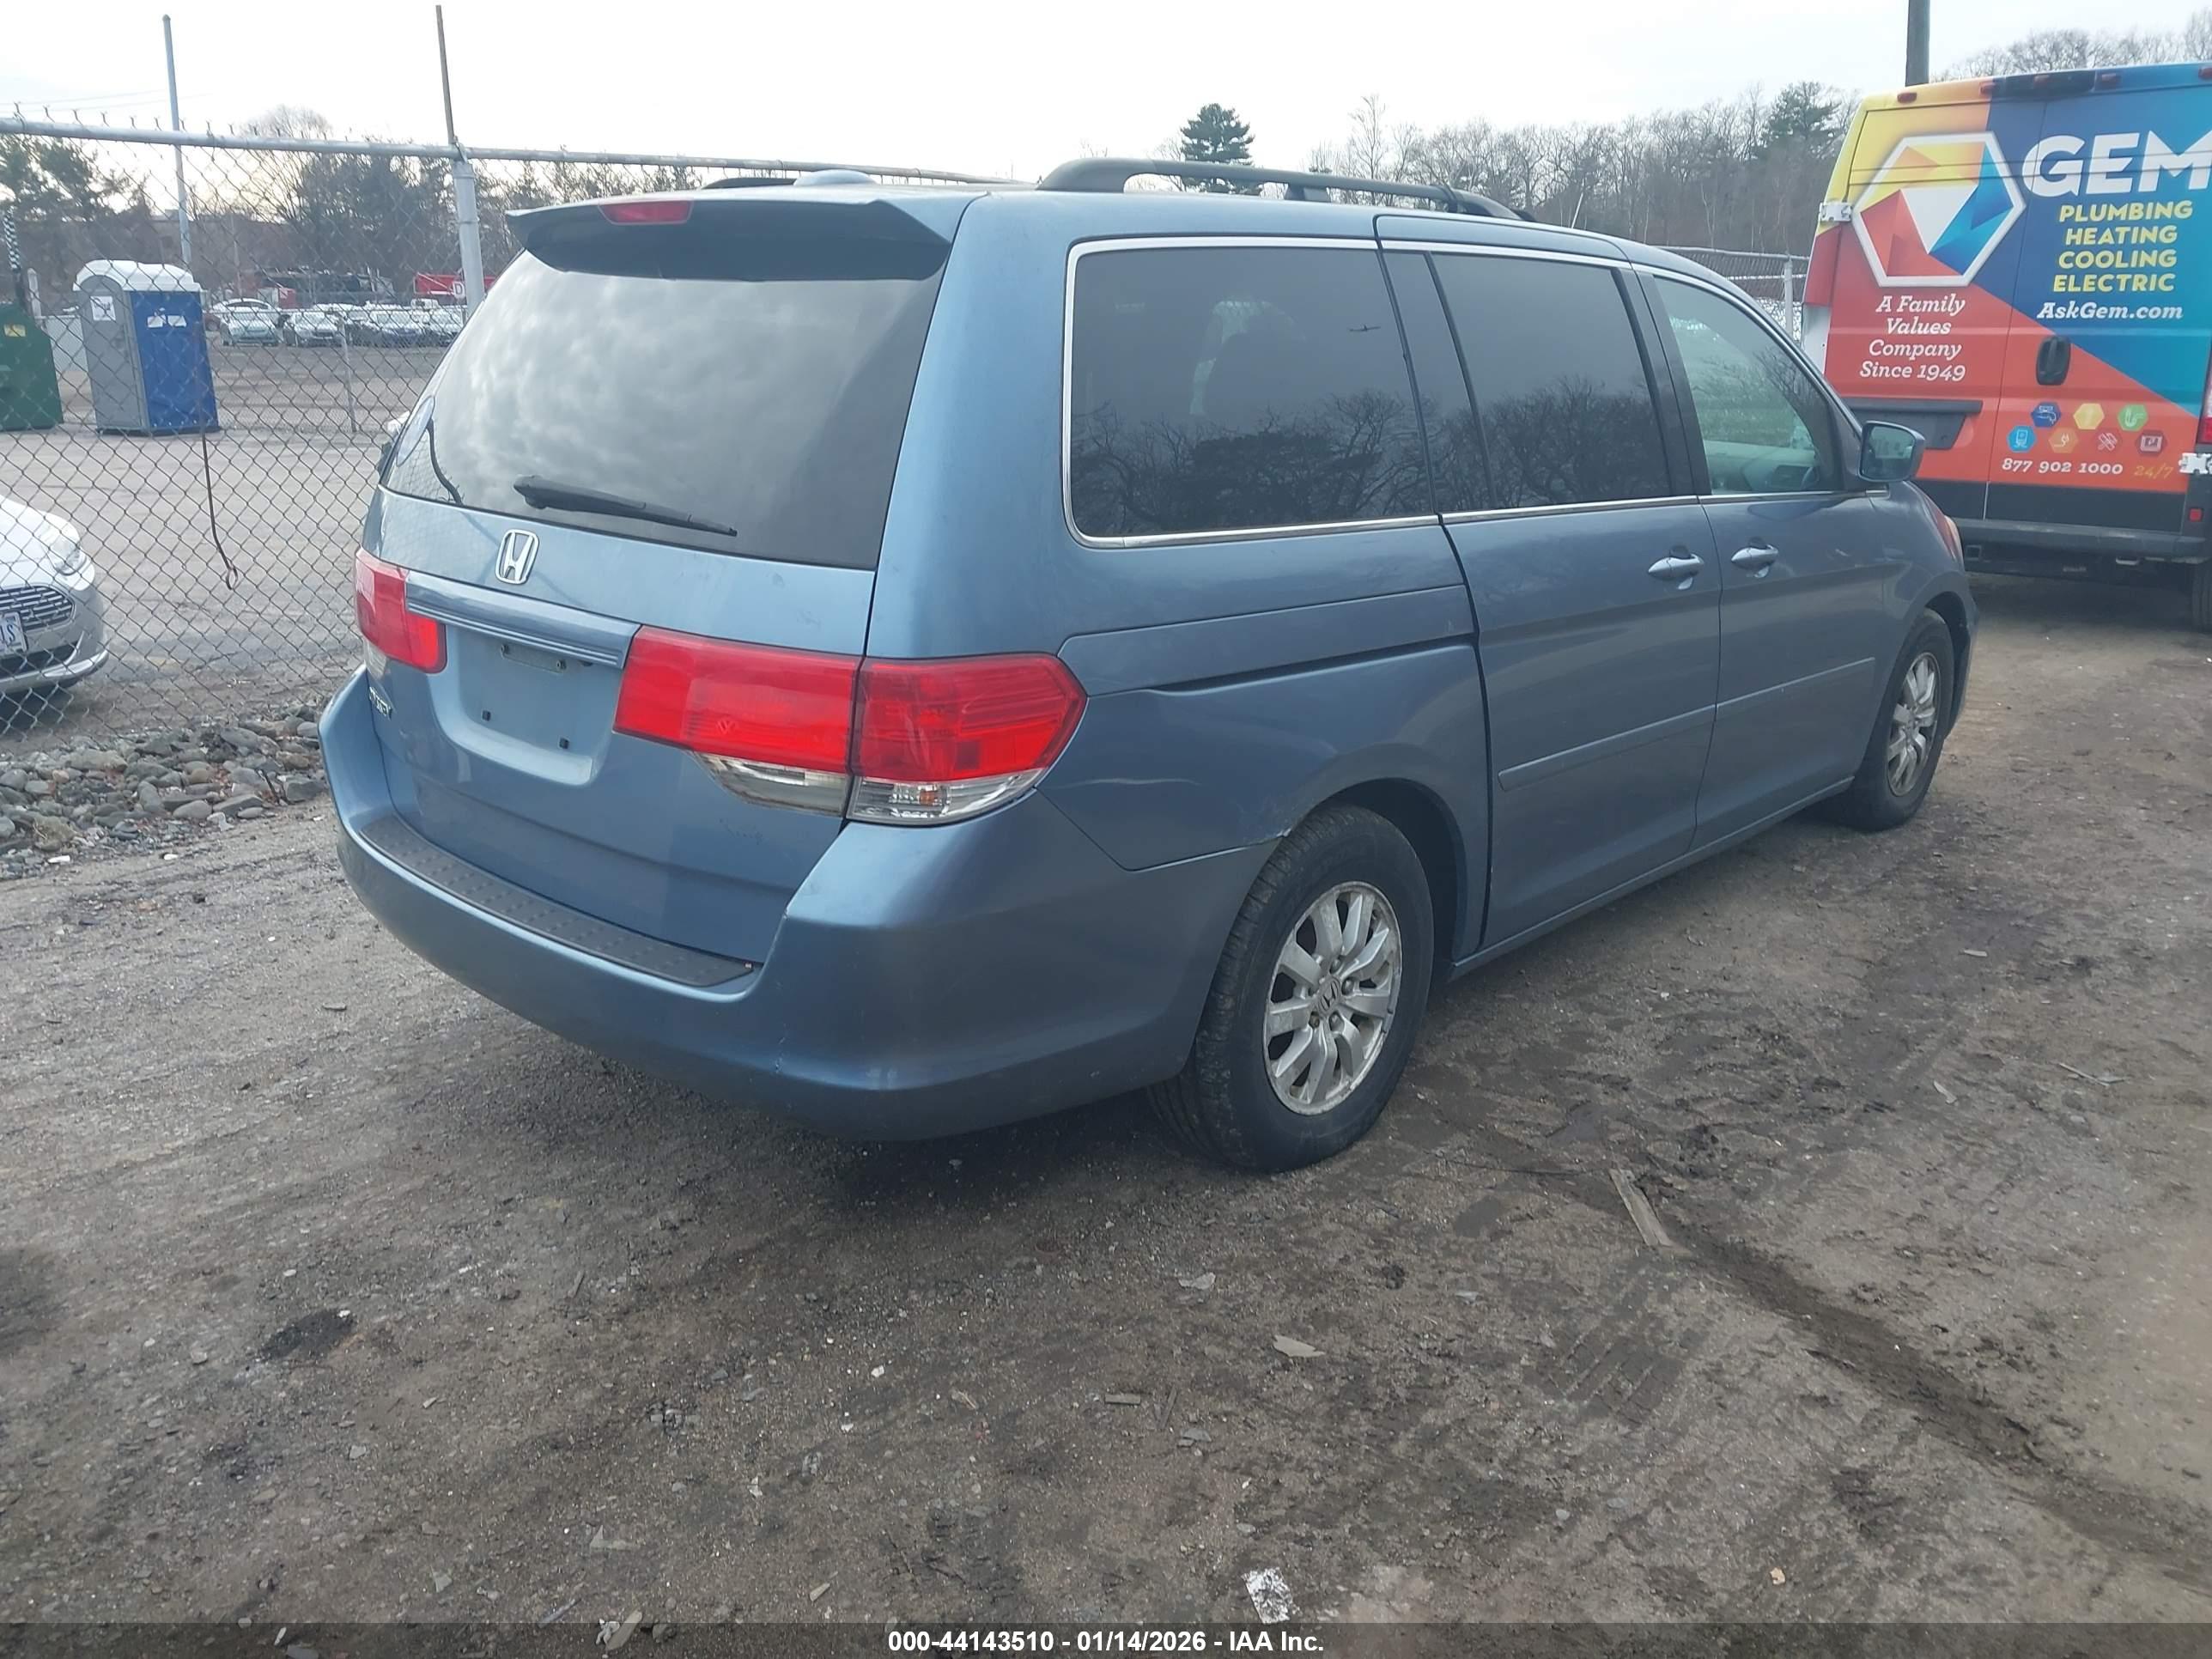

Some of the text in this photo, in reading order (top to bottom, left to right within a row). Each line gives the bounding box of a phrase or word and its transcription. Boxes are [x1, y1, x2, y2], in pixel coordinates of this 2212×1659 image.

[2021, 130, 2212, 198] GEM
[2058, 200, 2193, 222] PLUMBING
[2065, 225, 2178, 246] HEATING
[2058, 249, 2178, 269] COOLING
[2053, 273, 2176, 292] ELECTRIC
[1875, 293, 1966, 316] A Family
[2037, 301, 2184, 319] AskGem.com
[1887, 315, 1952, 335] Values
[1869, 338, 1963, 361] Company
[1859, 361, 1966, 381] Since 1949
[2002, 458, 2173, 479] 877 902 1000 24/7
